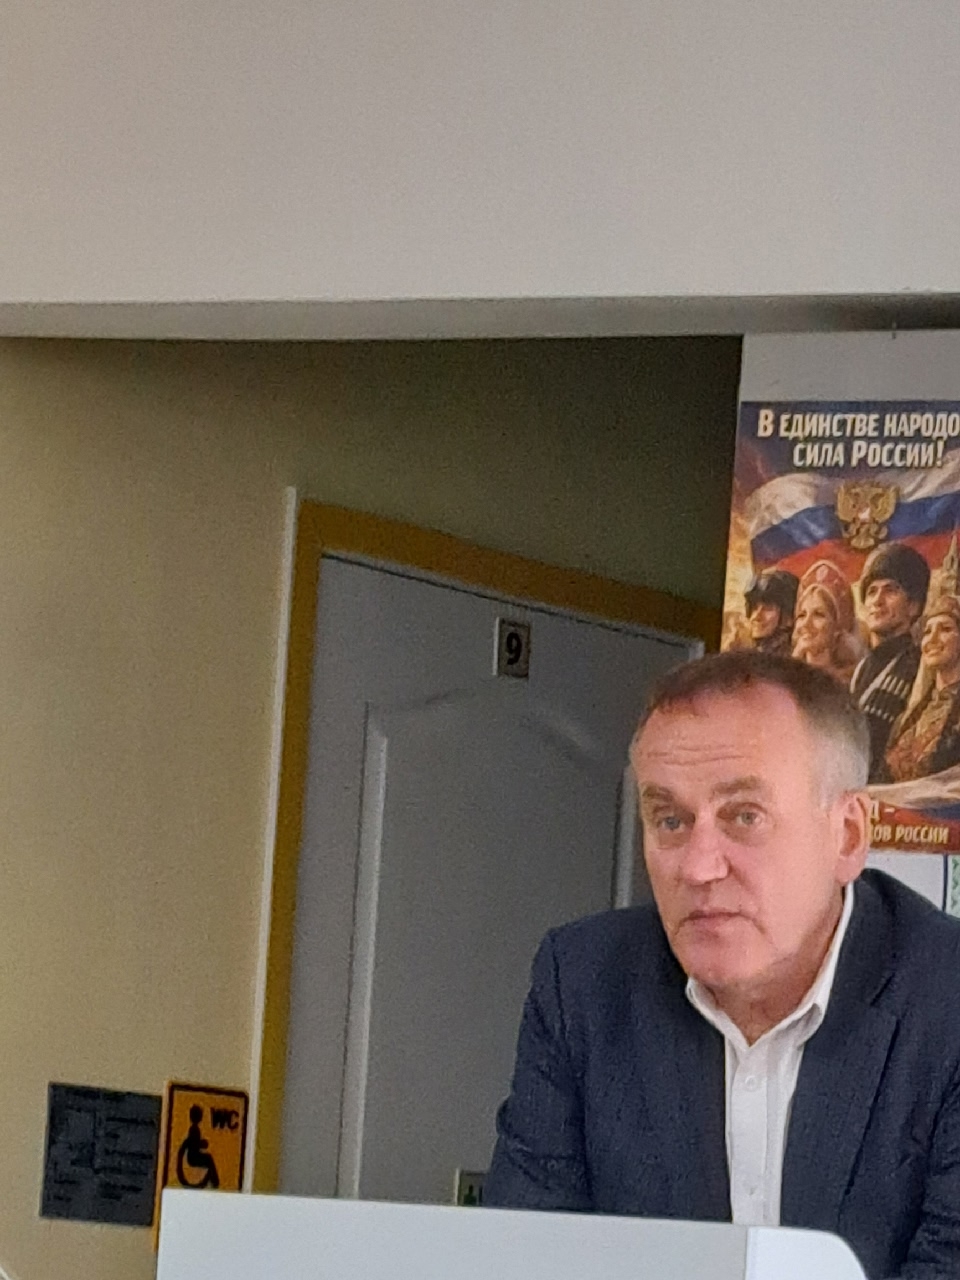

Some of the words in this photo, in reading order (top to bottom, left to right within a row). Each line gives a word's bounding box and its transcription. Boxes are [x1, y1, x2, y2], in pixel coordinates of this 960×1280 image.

[758, 409, 773, 437] В
[780, 413, 879, 440] ЕДИНСТВЕ
[793, 442, 845, 467] СИЛА
[506, 632, 522, 666] 9
[895, 825, 949, 844] РОССИИ
[209, 1106, 240, 1131] WC
